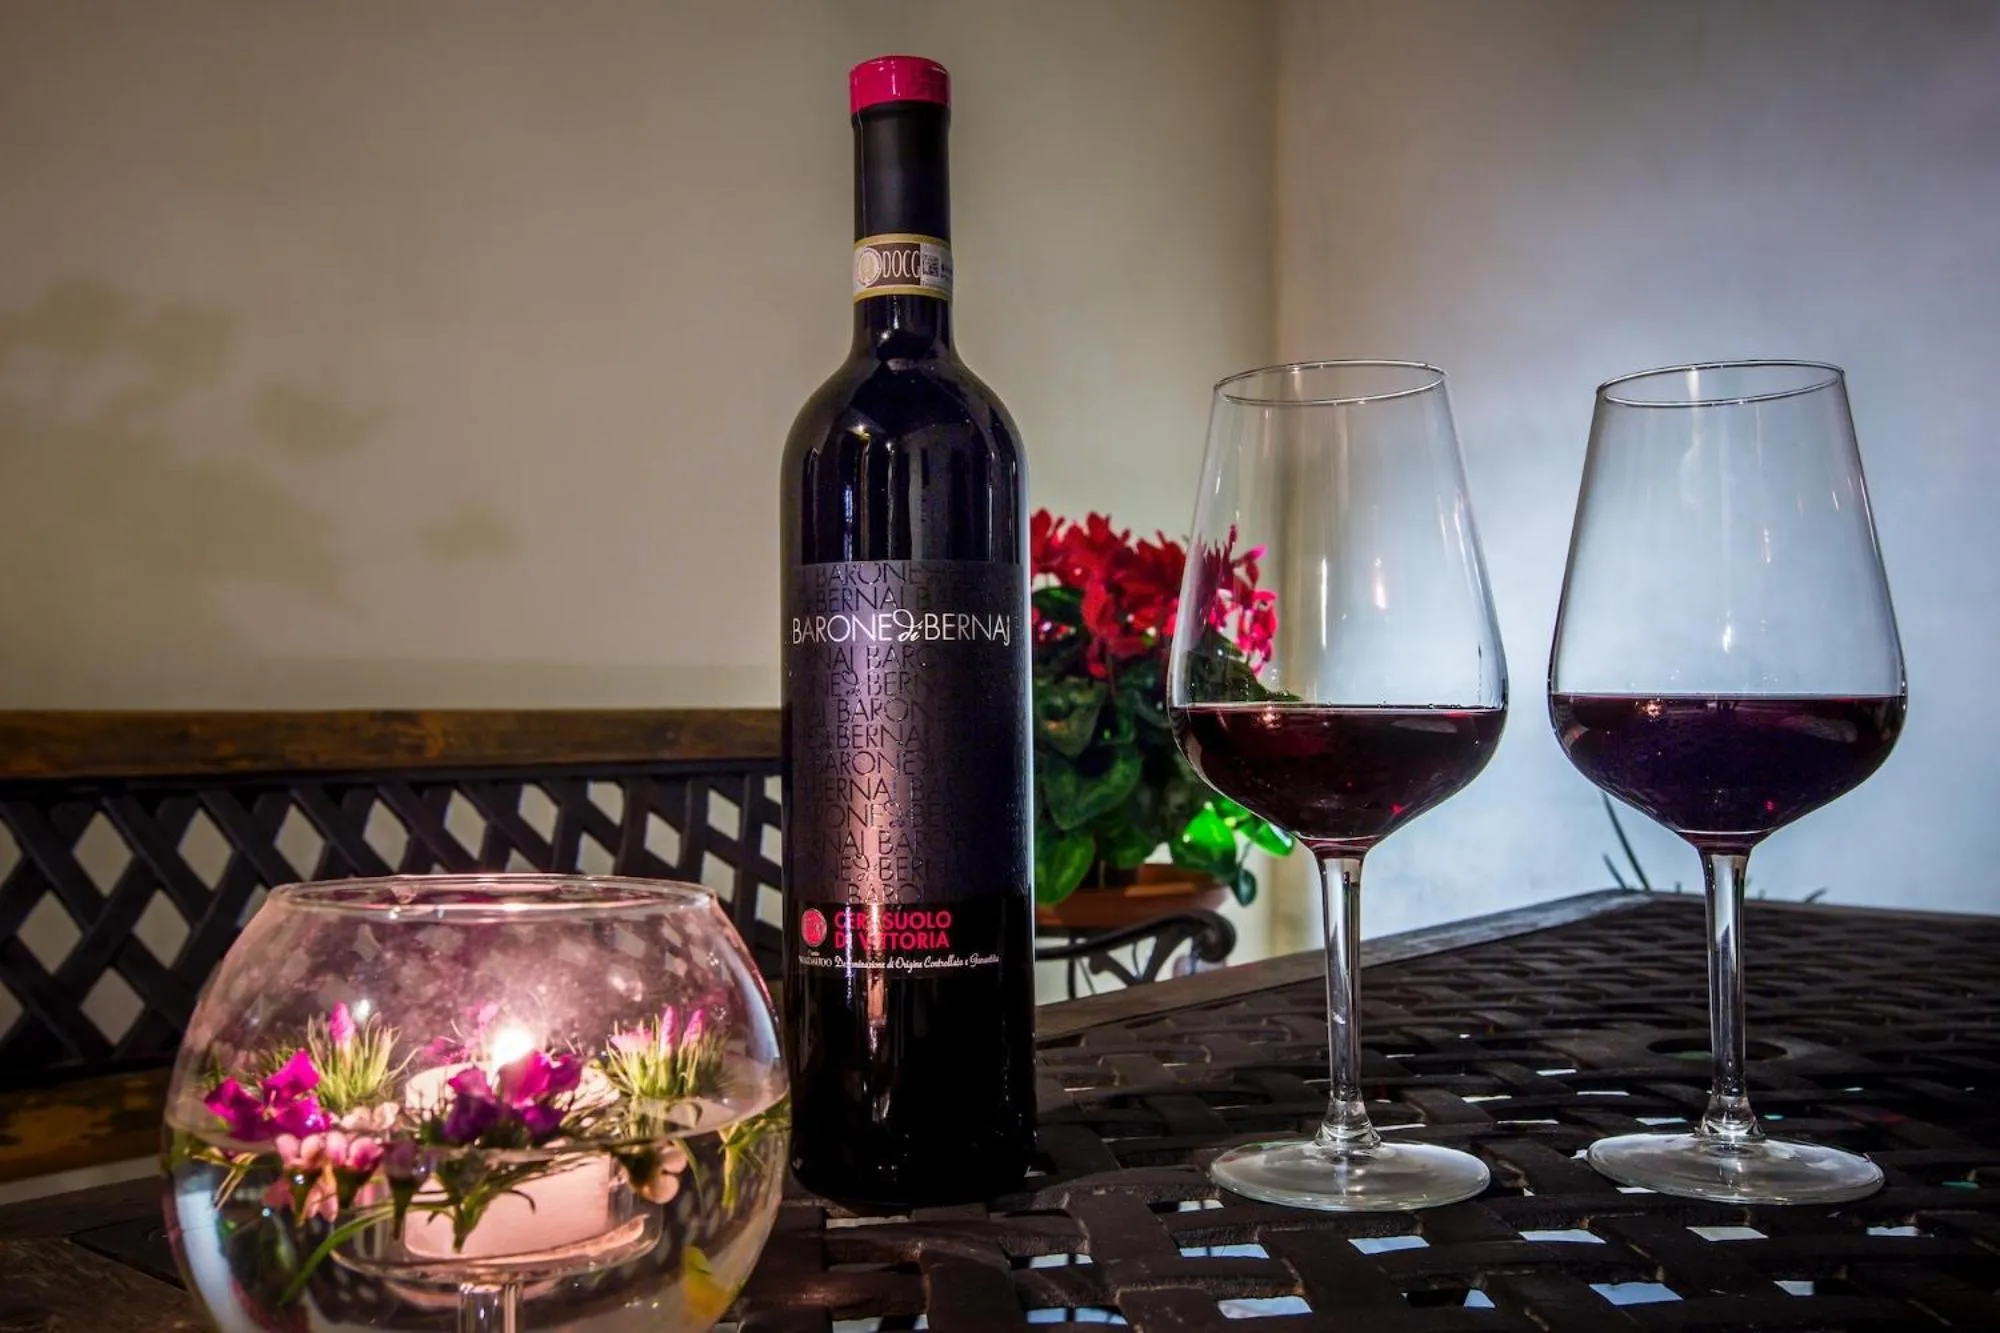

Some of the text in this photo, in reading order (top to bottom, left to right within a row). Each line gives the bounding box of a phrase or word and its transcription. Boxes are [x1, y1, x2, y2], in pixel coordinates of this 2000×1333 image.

[792, 612, 893, 644] BARONE
[893, 608, 923, 643] di
[834, 910, 951, 930] CERSUOLO
[835, 930, 950, 950] D VTTORIA
